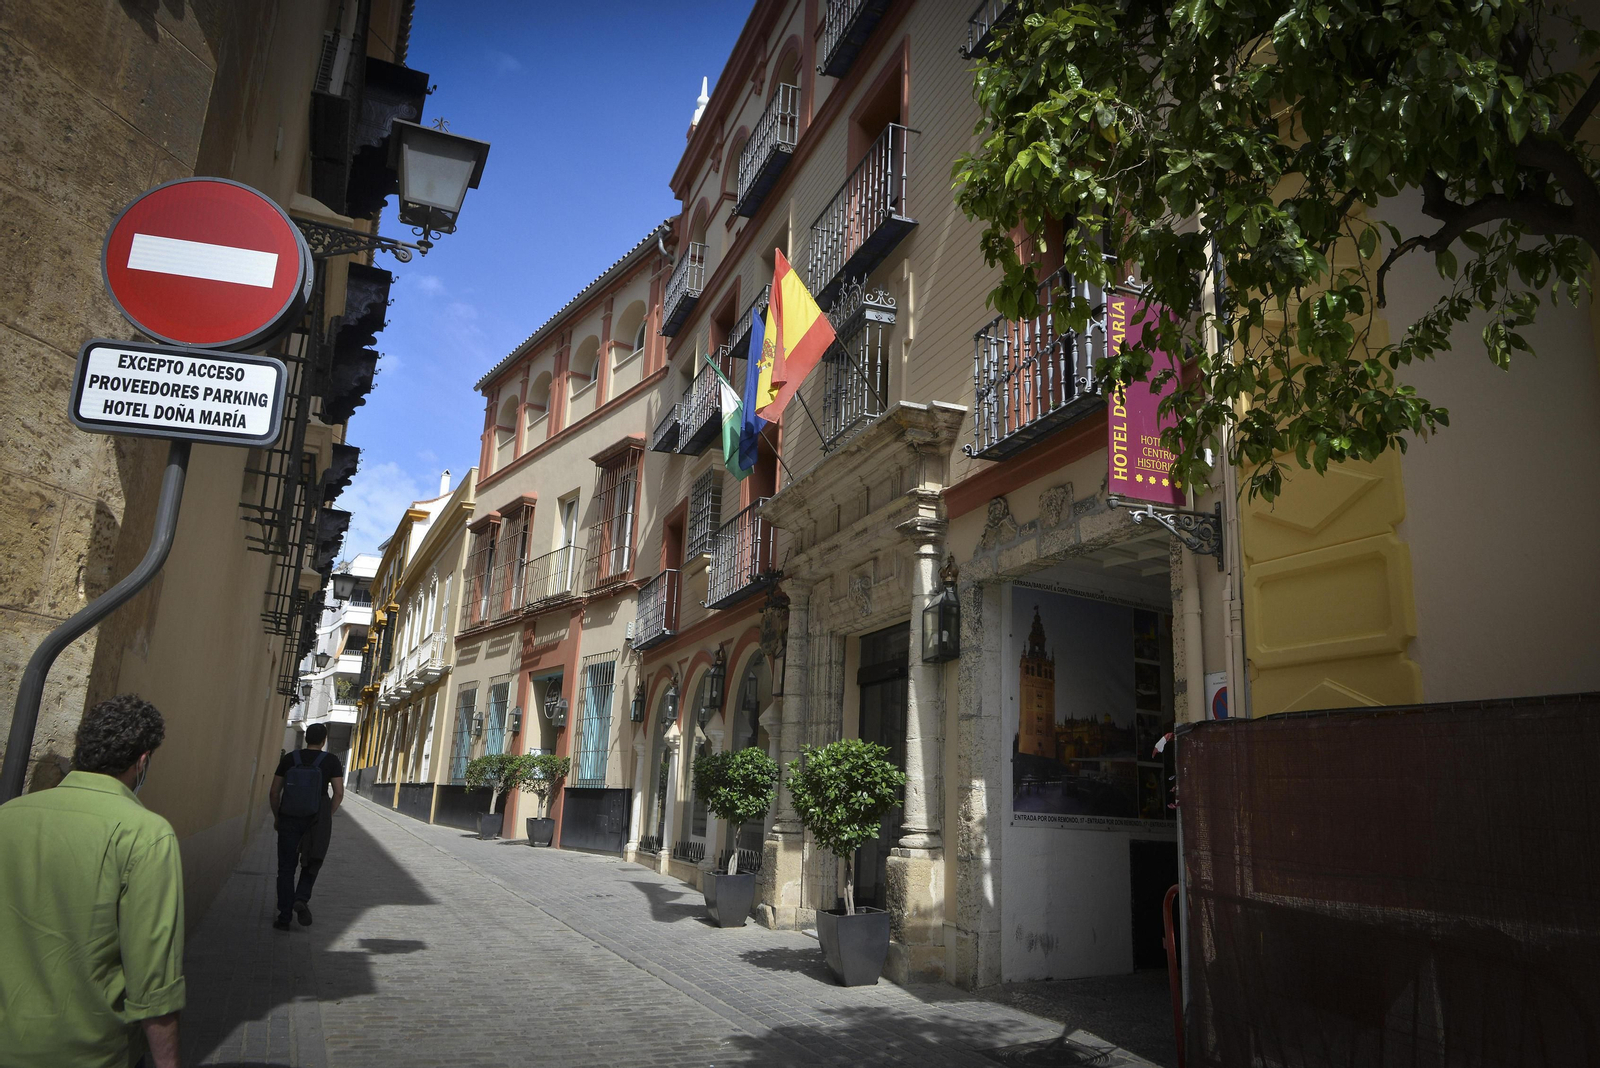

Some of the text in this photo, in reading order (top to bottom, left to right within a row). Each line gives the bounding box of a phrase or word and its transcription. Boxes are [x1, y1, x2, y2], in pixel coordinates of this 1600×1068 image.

[117, 353, 245, 382] EXCEPTO ACCESO
[88, 374, 269, 408] PROVEEDORES PARKING
[1113, 379, 1127, 418] DO
[102, 399, 247, 429] HOTEL DOÑA MARÍA
[1113, 422, 1128, 481] HOTEL
[1140, 435, 1169, 449] HOT
[1137, 457, 1178, 476] HISTÓRI
[1014, 814, 1037, 822] ENTRADA
